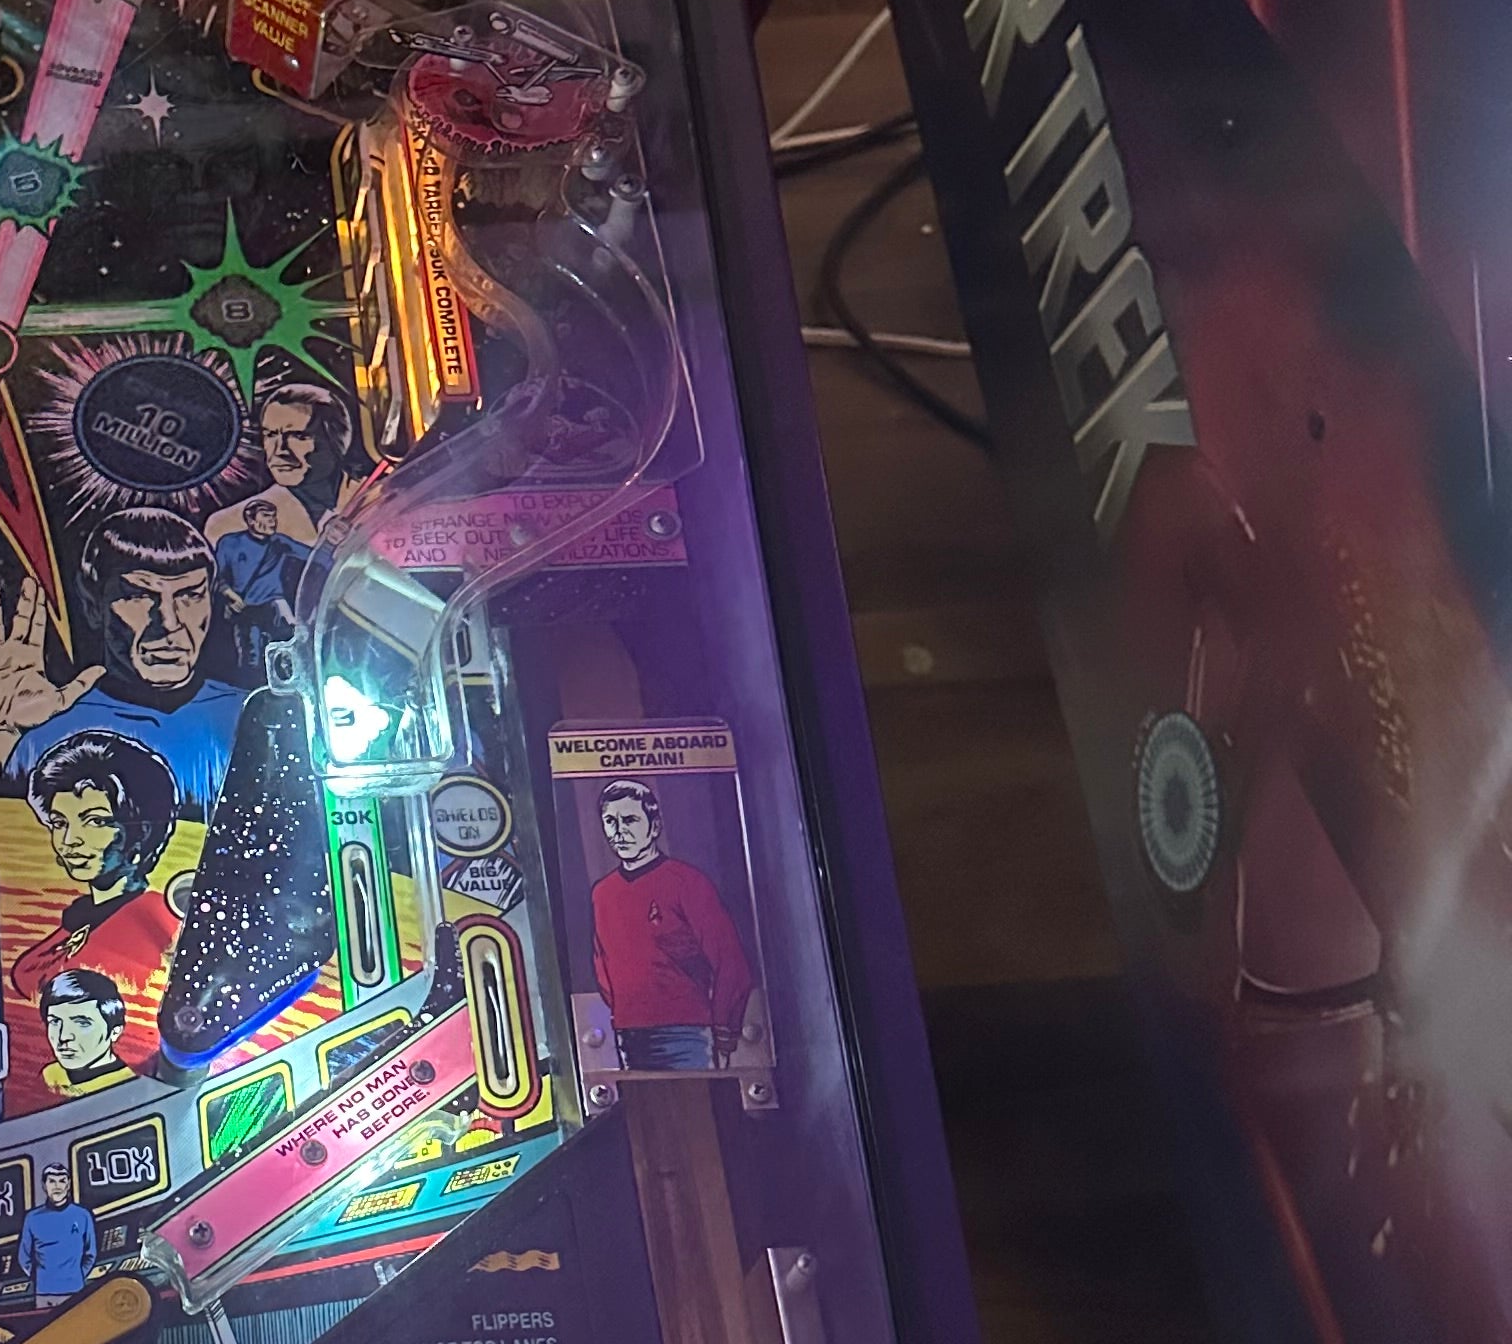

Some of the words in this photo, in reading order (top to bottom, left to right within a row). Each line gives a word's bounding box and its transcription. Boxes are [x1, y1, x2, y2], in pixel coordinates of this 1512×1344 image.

[253, 15, 296, 54] VALUE
[1004, 22, 1199, 548] TREK
[223, 299, 254, 323] 8
[436, 286, 463, 375] COMPLETE
[136, 403, 185, 439] 10
[92, 412, 201, 471] MILLION
[512, 494, 537, 511] TO
[411, 512, 497, 533] STRANGE
[411, 530, 459, 546] SEEK
[465, 529, 506, 545] OUT
[404, 548, 446, 564] AND
[554, 738, 646, 754] WELCOME
[652, 735, 728, 750] ABOARD
[600, 752, 685, 768] CAPTAIN!
[330, 810, 374, 826] 30K
[436, 808, 499, 823] SHIELDS
[469, 865, 497, 878] BIG
[275, 1110, 338, 1157] WHERE
[338, 1090, 366, 1114] NO
[365, 1059, 408, 1094] MAN
[332, 1108, 371, 1139] HAS
[372, 1075, 416, 1111] GONE
[360, 1089, 431, 1141] BEFORE.
[87, 1145, 157, 1187] 10X
[471, 1312, 555, 1332] FLIPPERS
